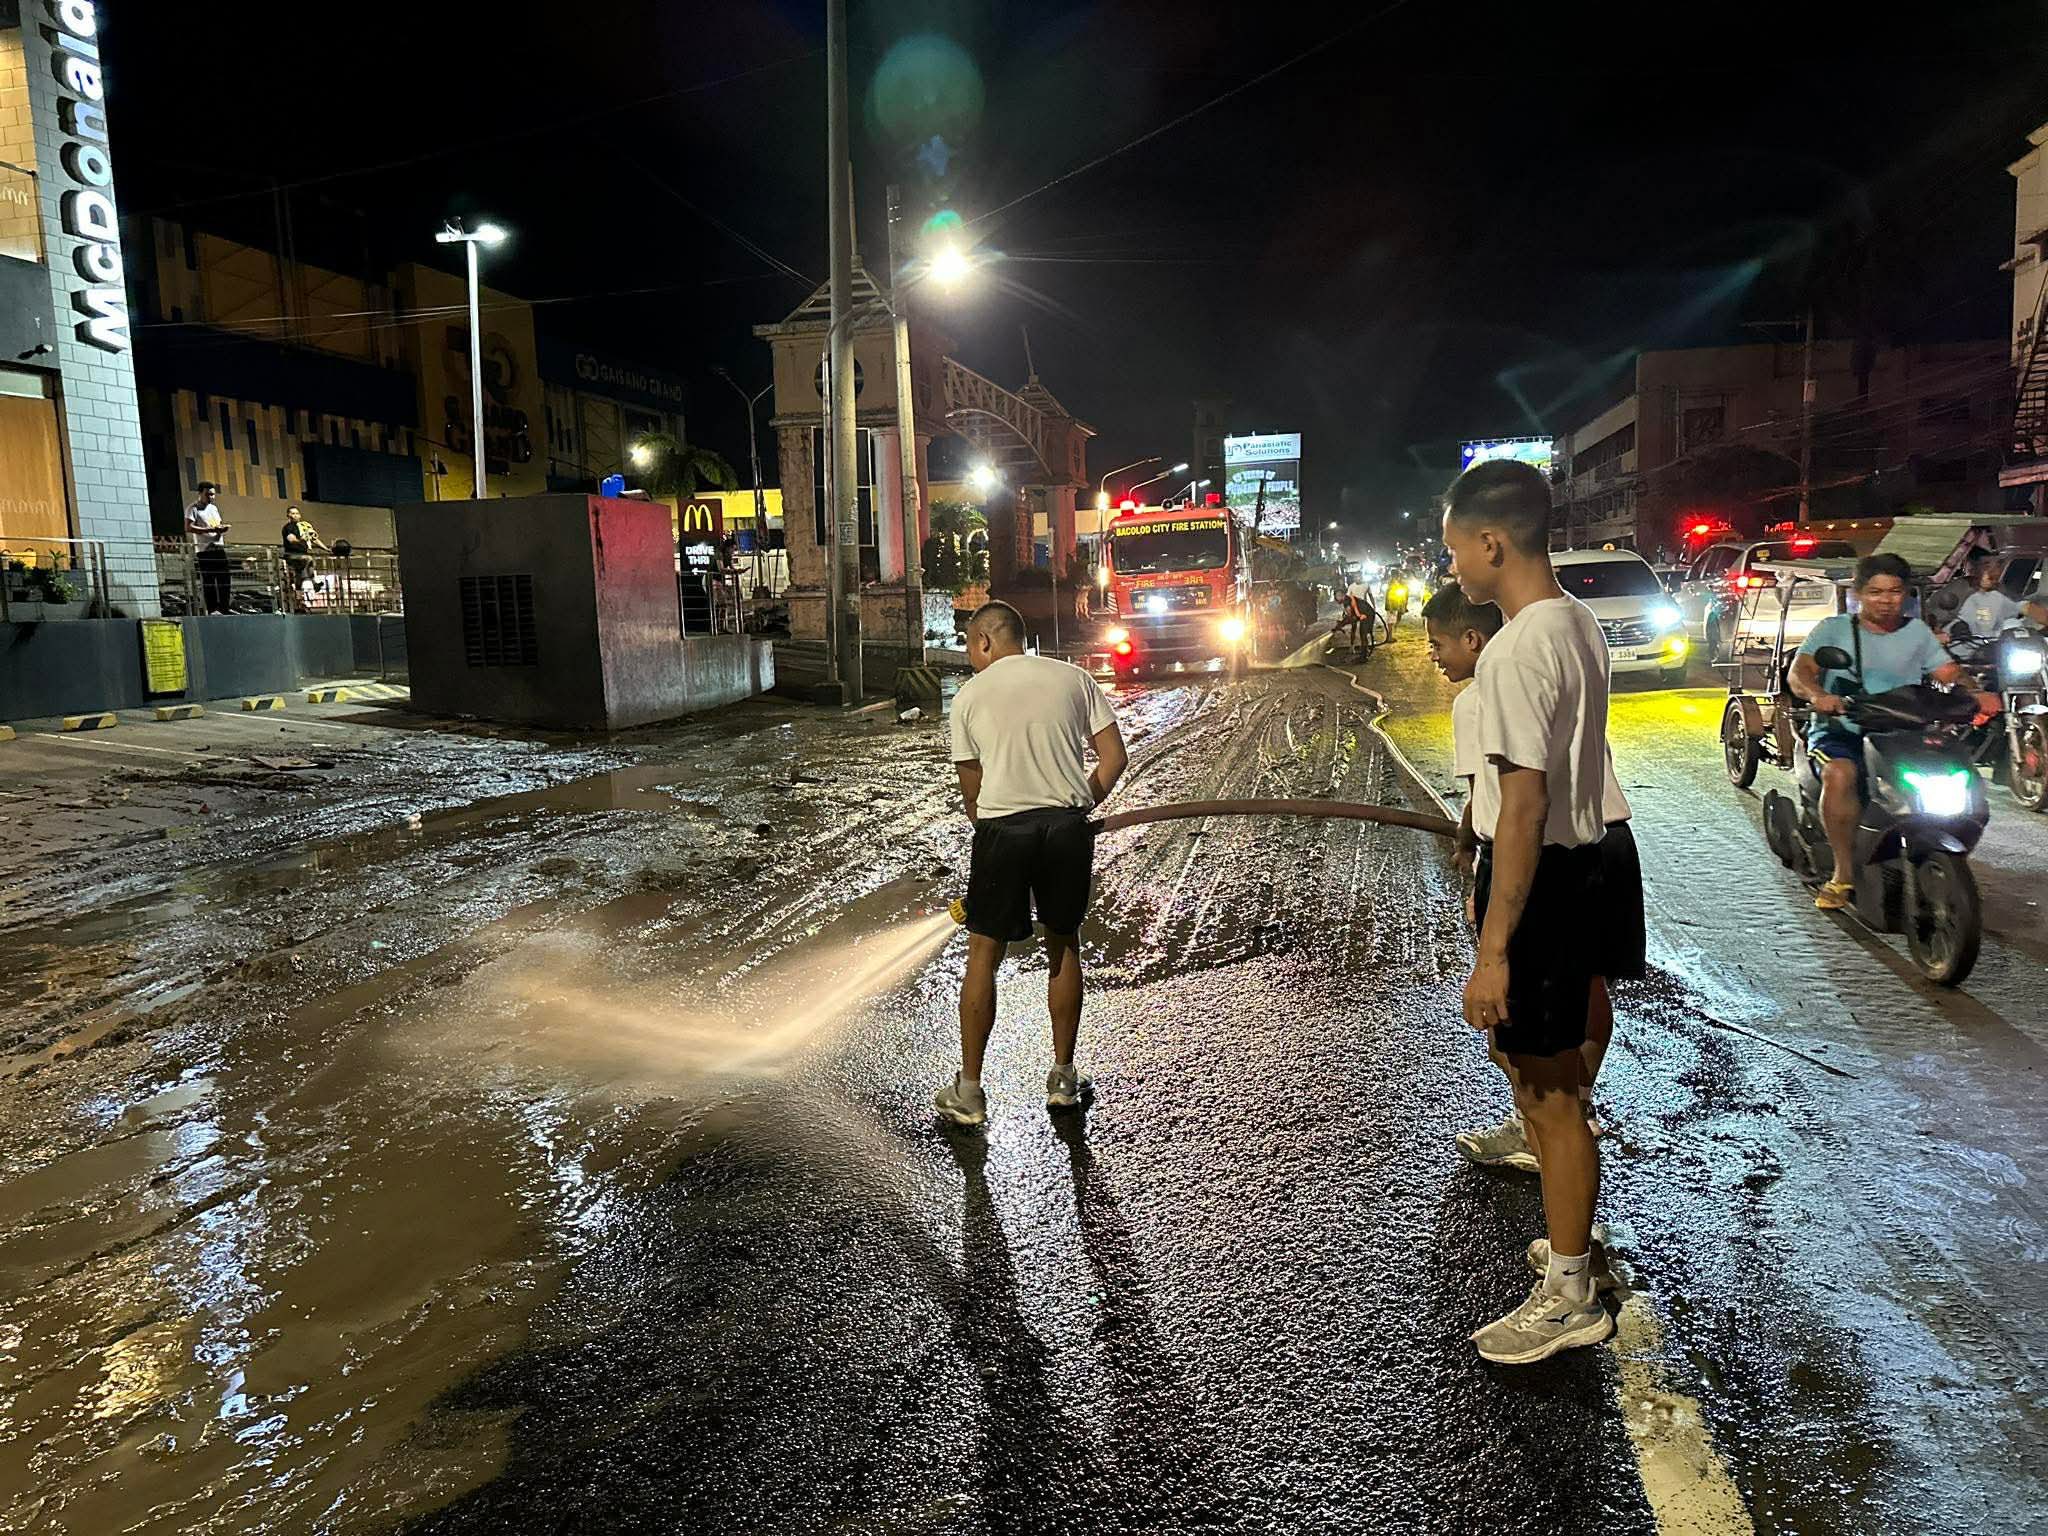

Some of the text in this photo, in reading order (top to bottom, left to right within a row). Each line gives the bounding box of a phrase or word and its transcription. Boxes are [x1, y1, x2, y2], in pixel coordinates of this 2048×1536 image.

[1243, 441, 1292, 450] Panasiatic
[1245, 447, 1290, 456] Solutions
[1116, 520, 1223, 537] BACOLOD CITY FIRE STATION
[685, 545, 715, 556] DRIVE
[1135, 579, 1155, 588] FIRE
